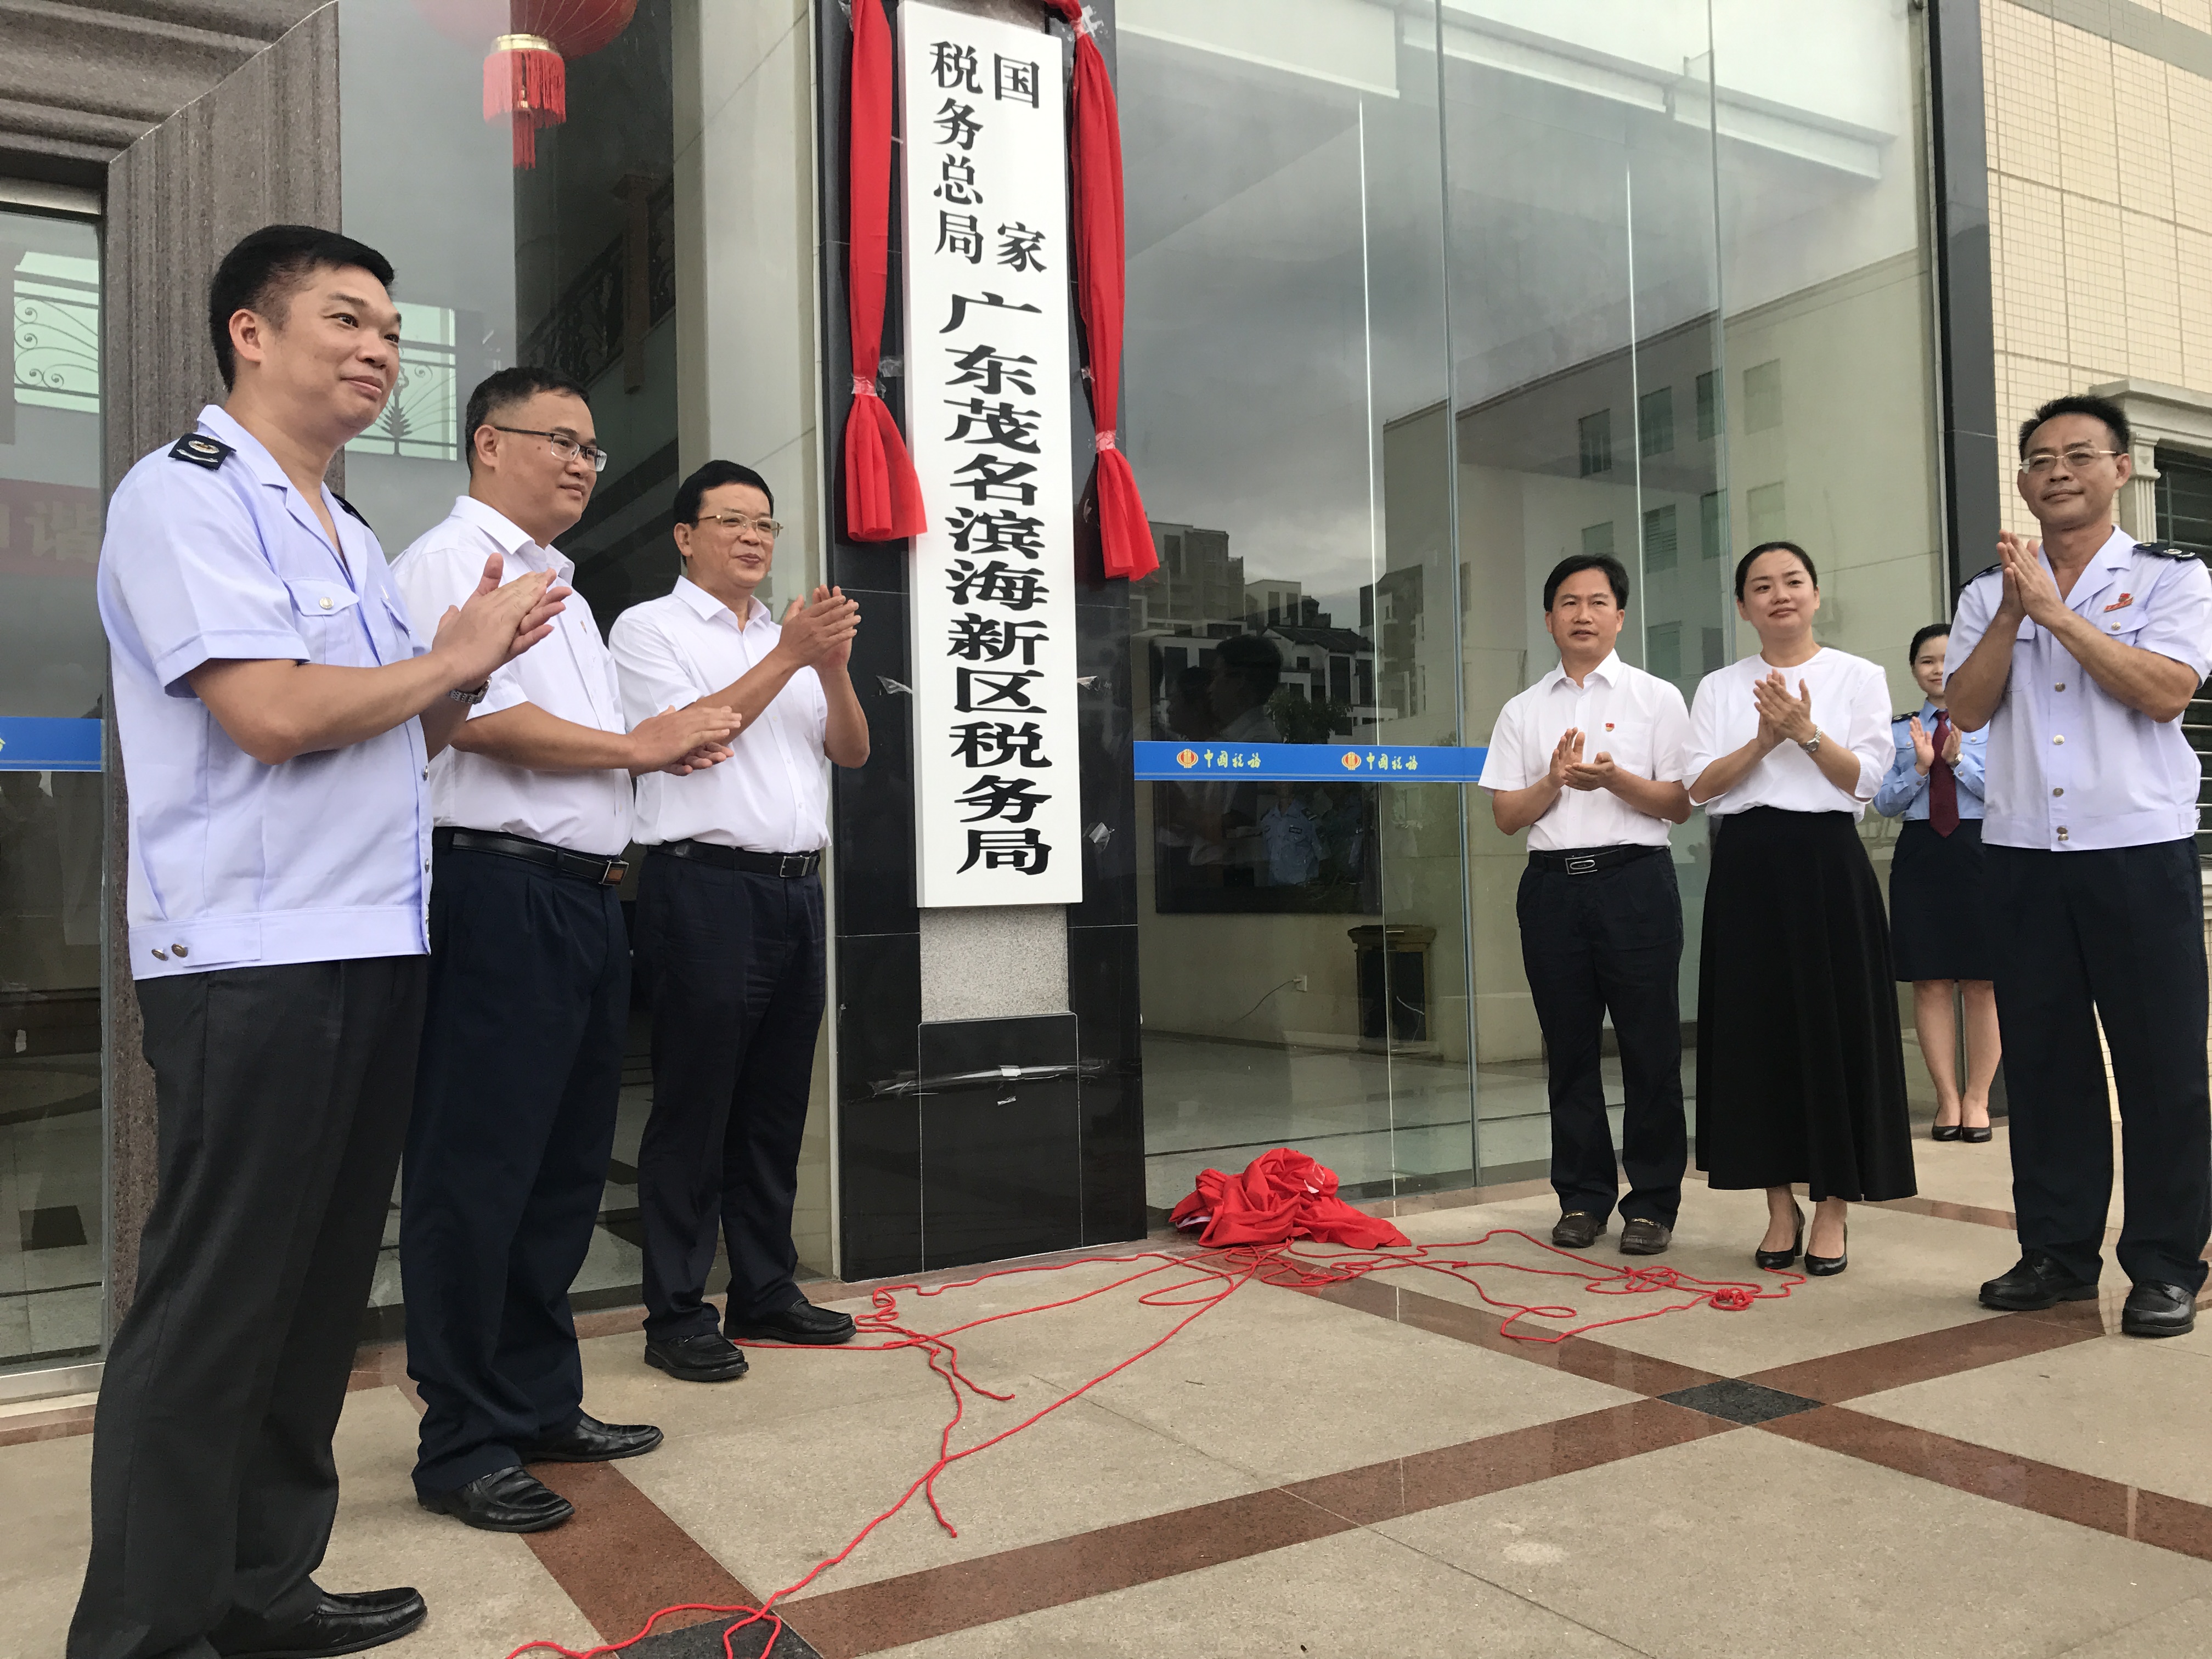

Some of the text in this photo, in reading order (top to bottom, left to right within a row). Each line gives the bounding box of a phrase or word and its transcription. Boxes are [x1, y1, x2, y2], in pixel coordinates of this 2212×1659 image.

[929, 40, 984, 264] 税务总局
[994, 53, 1048, 273] 国家
[939, 291, 1053, 876] 广东茂名滨海新区税务局
